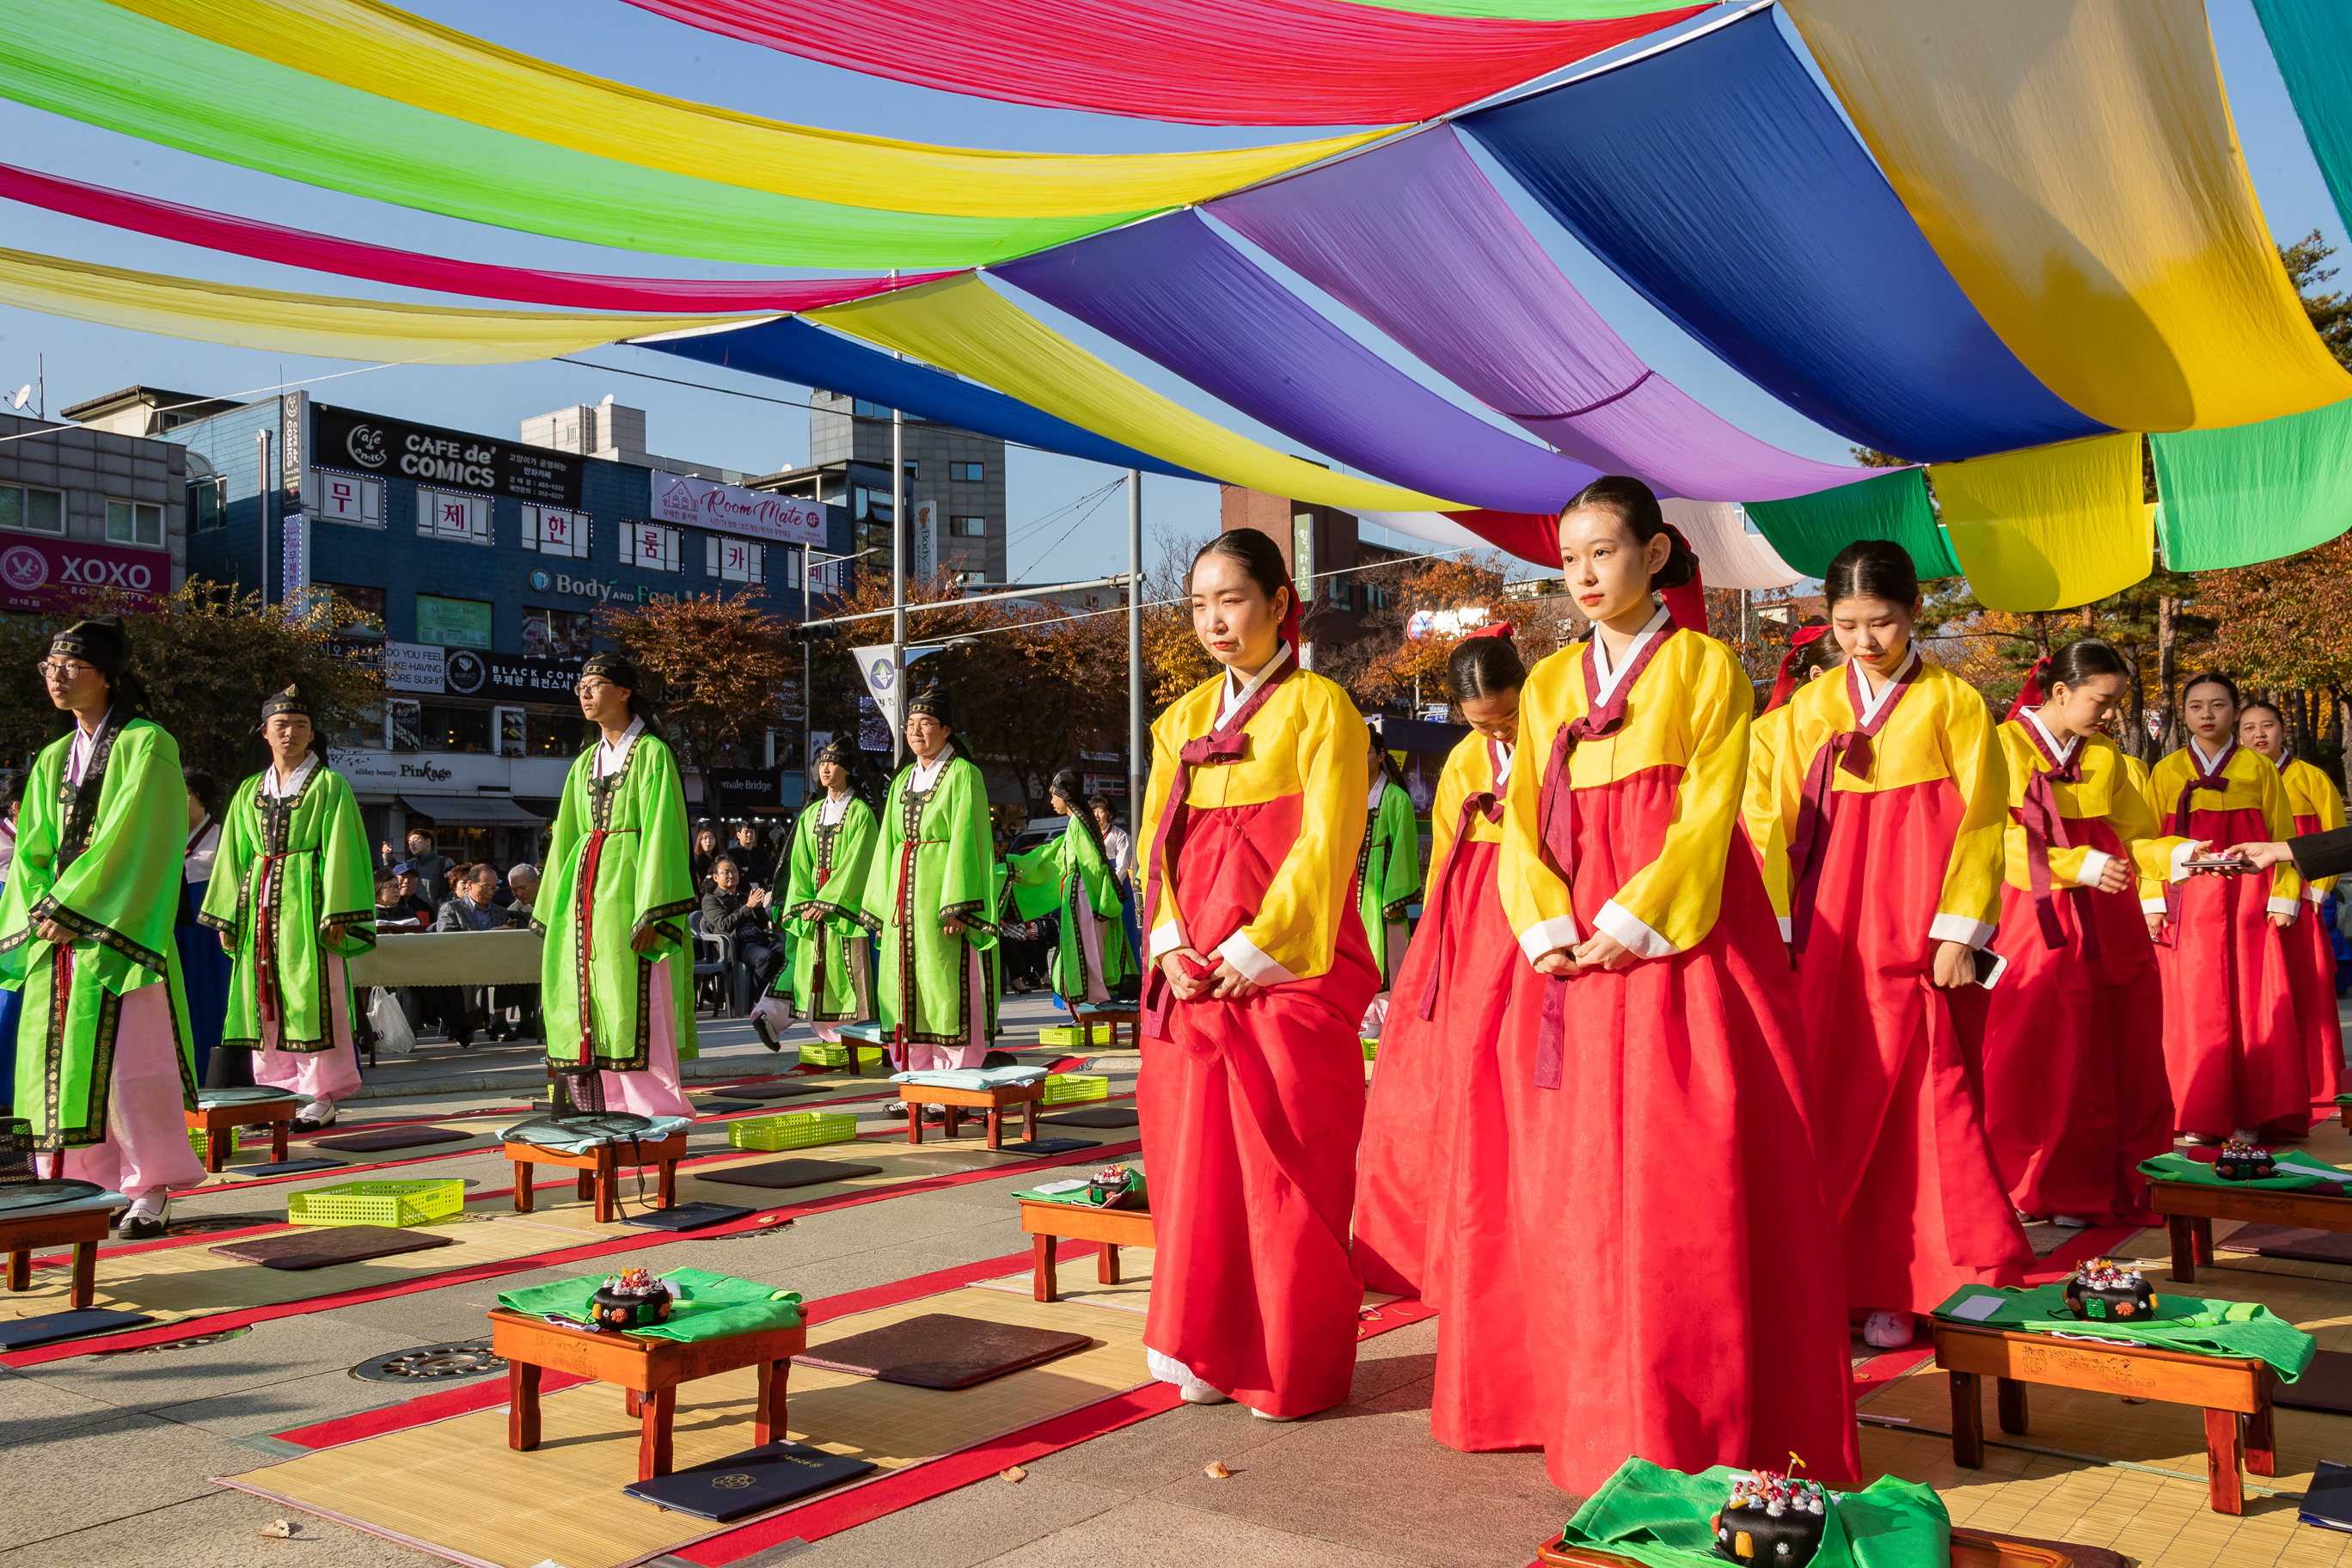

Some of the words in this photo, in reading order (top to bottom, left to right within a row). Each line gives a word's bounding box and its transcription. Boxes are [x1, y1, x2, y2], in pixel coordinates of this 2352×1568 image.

[405, 434, 461, 459] CAFE
[464, 444, 497, 464] de'
[400, 454, 495, 487] COMICS
[509, 453, 536, 466] 고양이가
[540, 459, 567, 472] 운영하는
[524, 467, 552, 480] 만화카페
[537, 490, 564, 500] 312-2221
[663, 508, 680, 519] 무제한
[701, 490, 752, 518] Room
[753, 500, 804, 528] Mate
[330, 482, 353, 513] 무
[444, 504, 465, 531] 제
[548, 515, 567, 543] 한
[644, 530, 659, 559] 룸
[728, 546, 745, 571] 카
[807, 514, 818, 525] 4F
[921, 530, 929, 564] Body
[289, 550, 297, 586] 무제한
[1298, 528, 1309, 591] 힐스하우스
[60, 555, 151, 589] XOXO
[71, 586, 107, 597] ROM
[555, 573, 612, 603] Body
[612, 591, 634, 601] AND
[387, 648, 400, 657] DO
[402, 649, 420, 659] YOU
[423, 652, 444, 662] FEEL
[389, 661, 407, 671] LIKE
[409, 662, 442, 673] HAVING
[493, 665, 538, 677] BLACK
[387, 673, 412, 683] MORE
[414, 675, 444, 687] SUSHI?
[493, 675, 524, 687] 무제한
[530, 677, 570, 690] 회전스시
[355, 768, 375, 777] allday
[376, 769, 397, 777] beauty
[399, 760, 452, 781] Pinkage
[745, 780, 772, 792] Bridge
